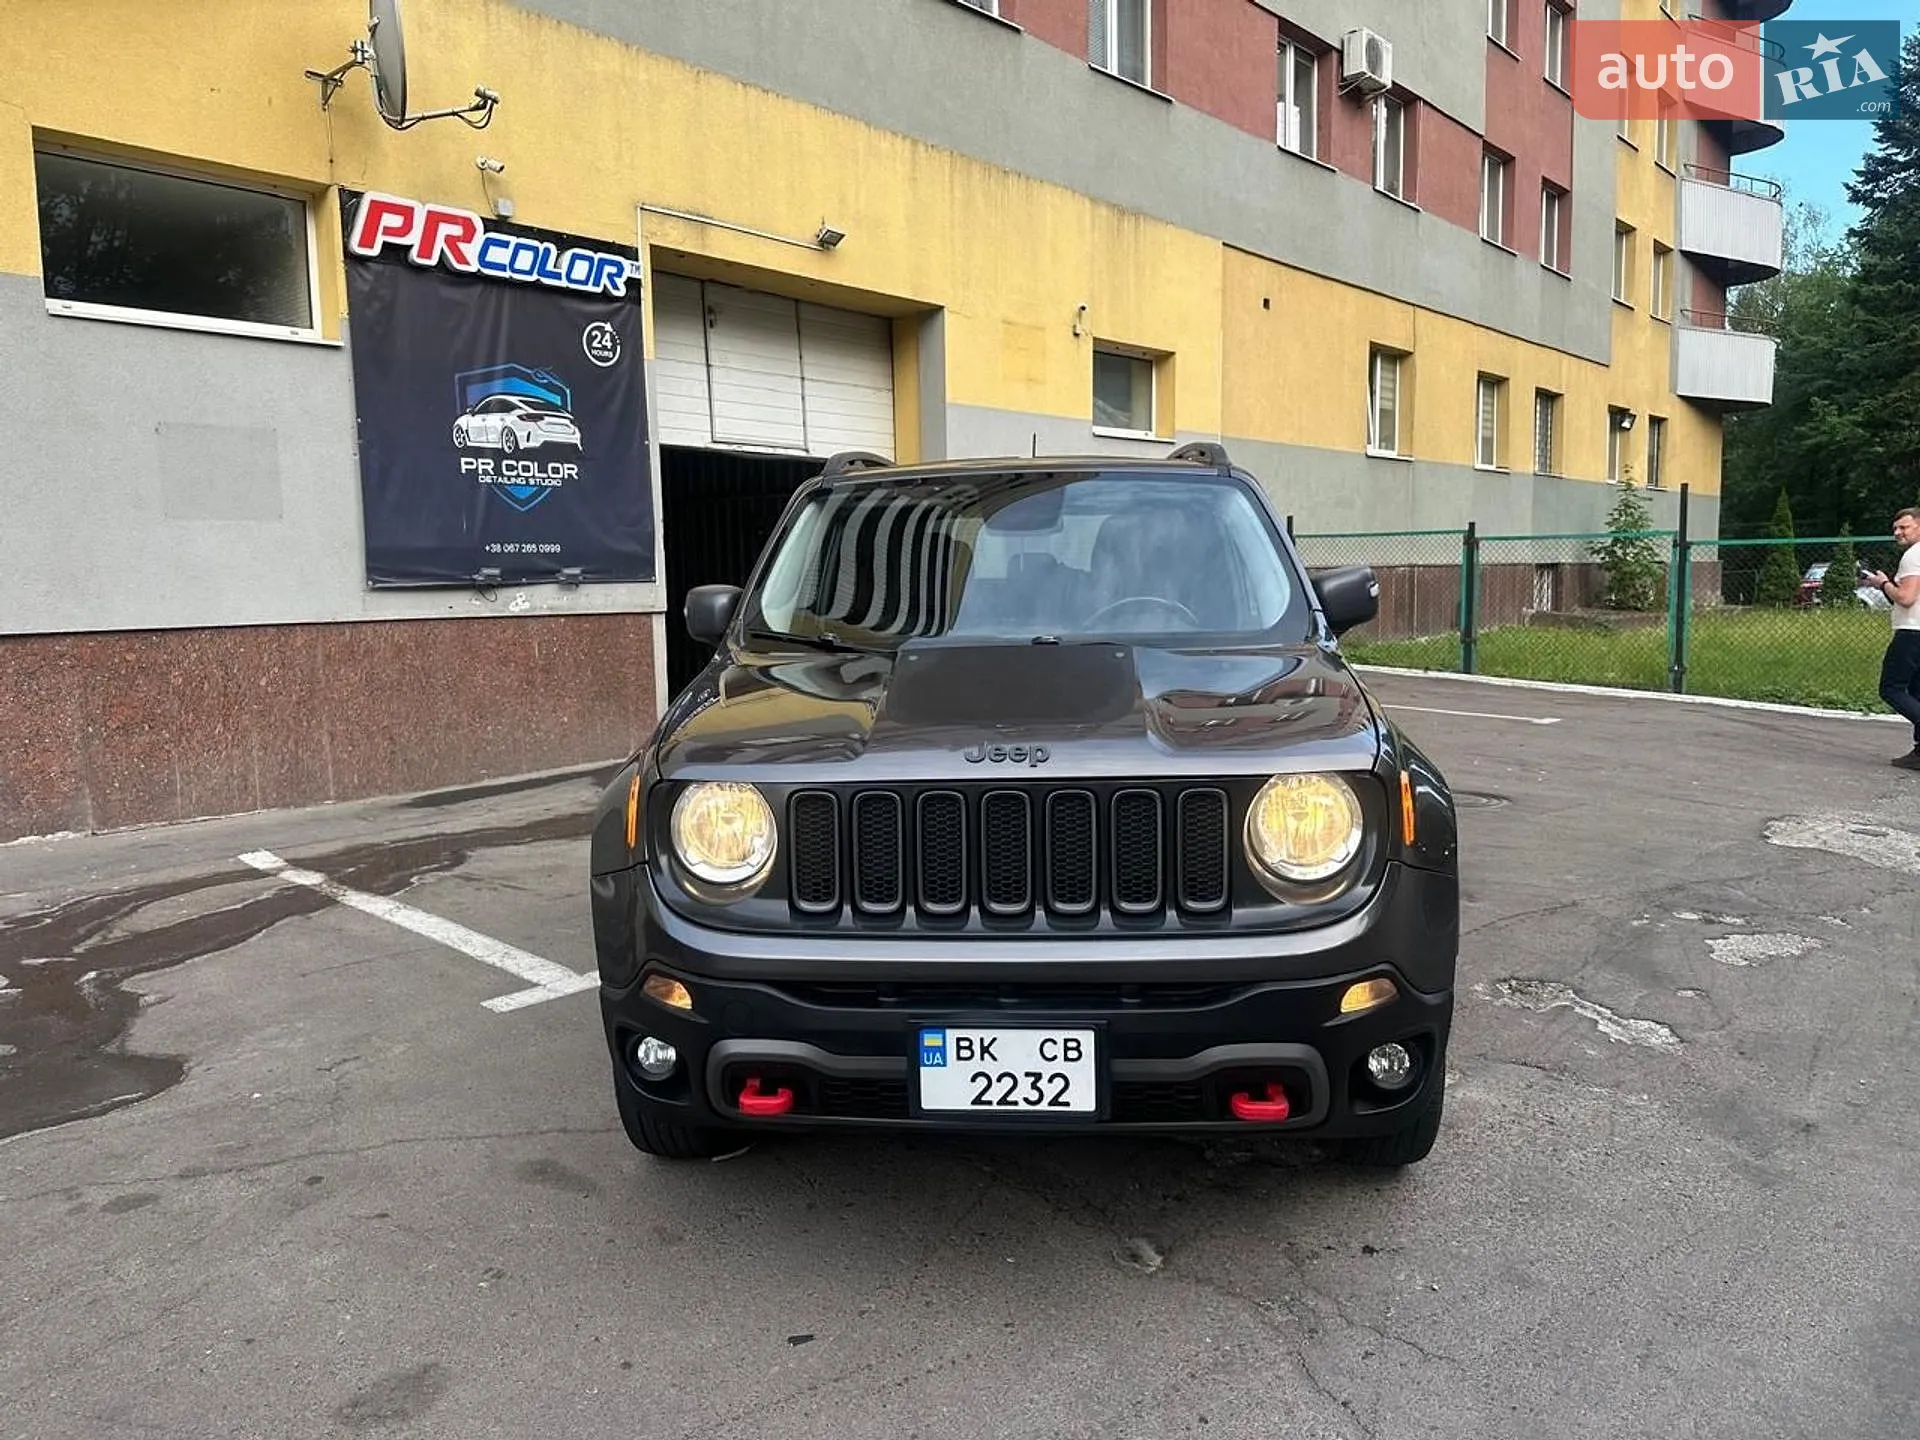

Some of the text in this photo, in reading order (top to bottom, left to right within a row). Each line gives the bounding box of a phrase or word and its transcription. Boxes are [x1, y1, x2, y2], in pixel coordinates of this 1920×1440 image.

[357, 200, 477, 267] PR
[478, 237, 625, 292] COLOR
[592, 330, 612, 348] 24
[591, 348, 613, 358] HOURS
[460, 457, 579, 479] PR COLOR
[479, 475, 562, 486] DETAILING STUDIO
[485, 543, 501, 553] +38
[503, 543, 520, 553] 067
[964, 742, 1050, 767] Jeep
[923, 1052, 943, 1065] UA
[955, 1037, 1083, 1062] BK CB
[970, 1071, 1071, 1107] 2232
